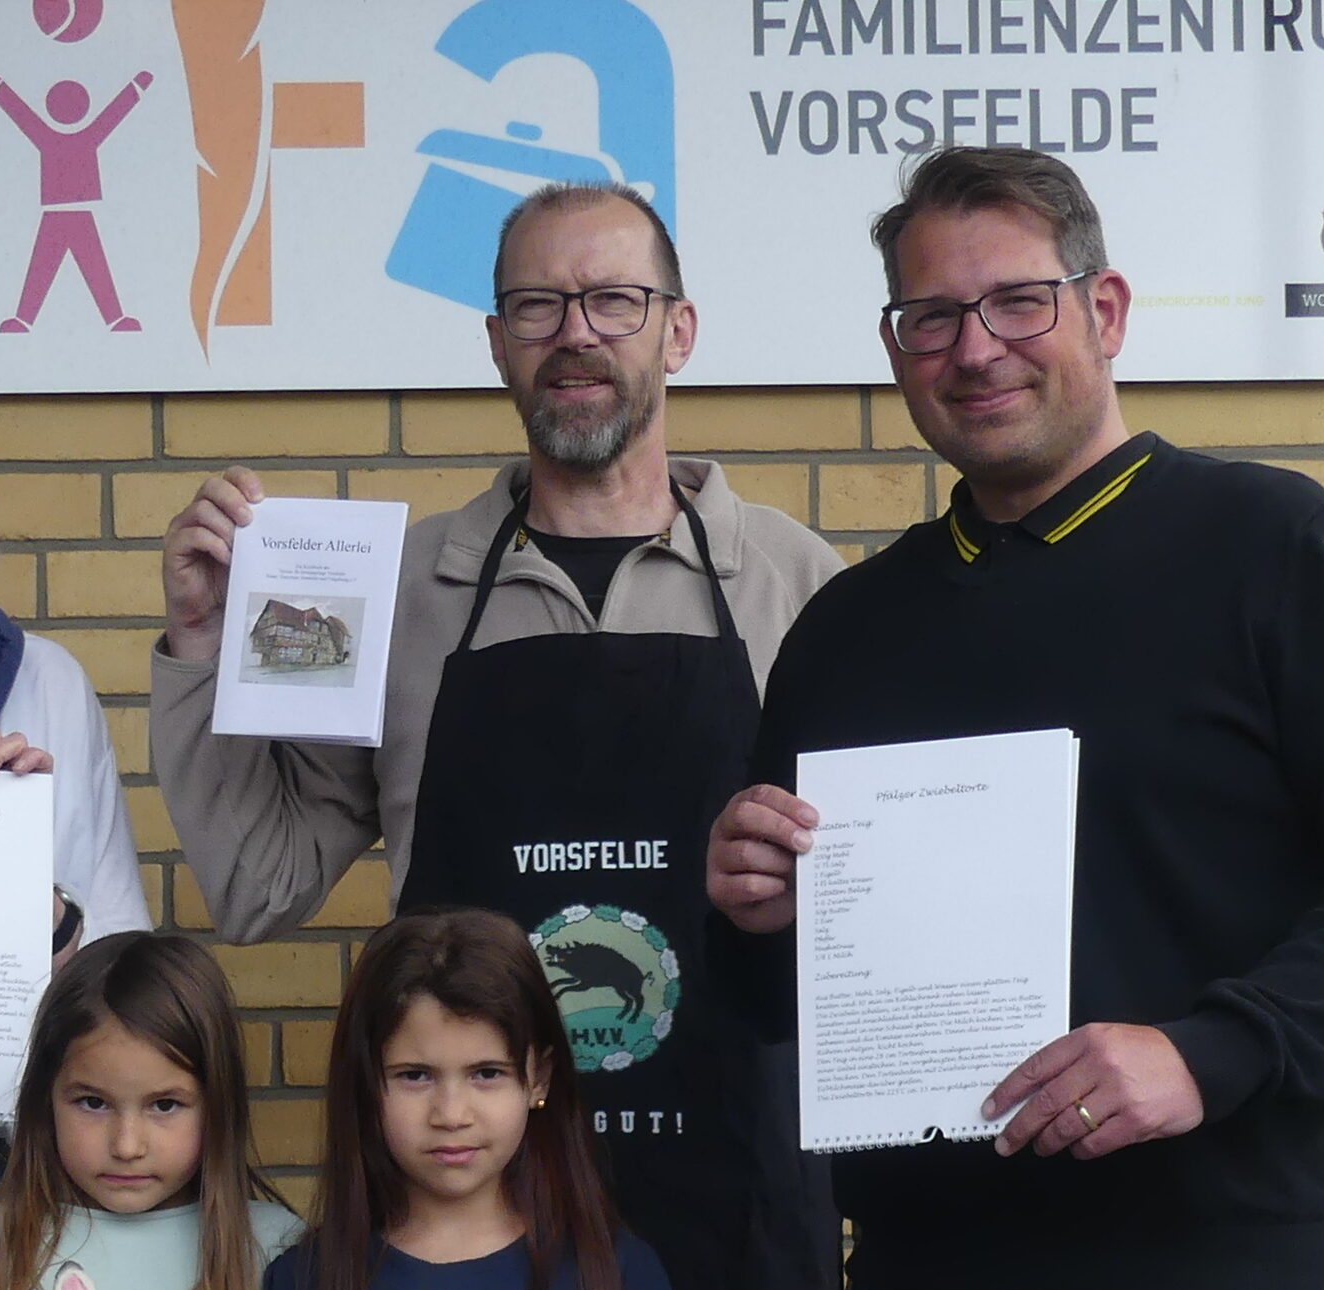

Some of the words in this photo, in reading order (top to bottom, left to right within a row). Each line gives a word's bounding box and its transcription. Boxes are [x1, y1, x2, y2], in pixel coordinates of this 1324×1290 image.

[748, 86, 1159, 156] VORSFELDE
[260, 536, 323, 551] Vorsfelder
[325, 539, 373, 554] Allerlei
[513, 840, 669, 873] VORSFELDE
